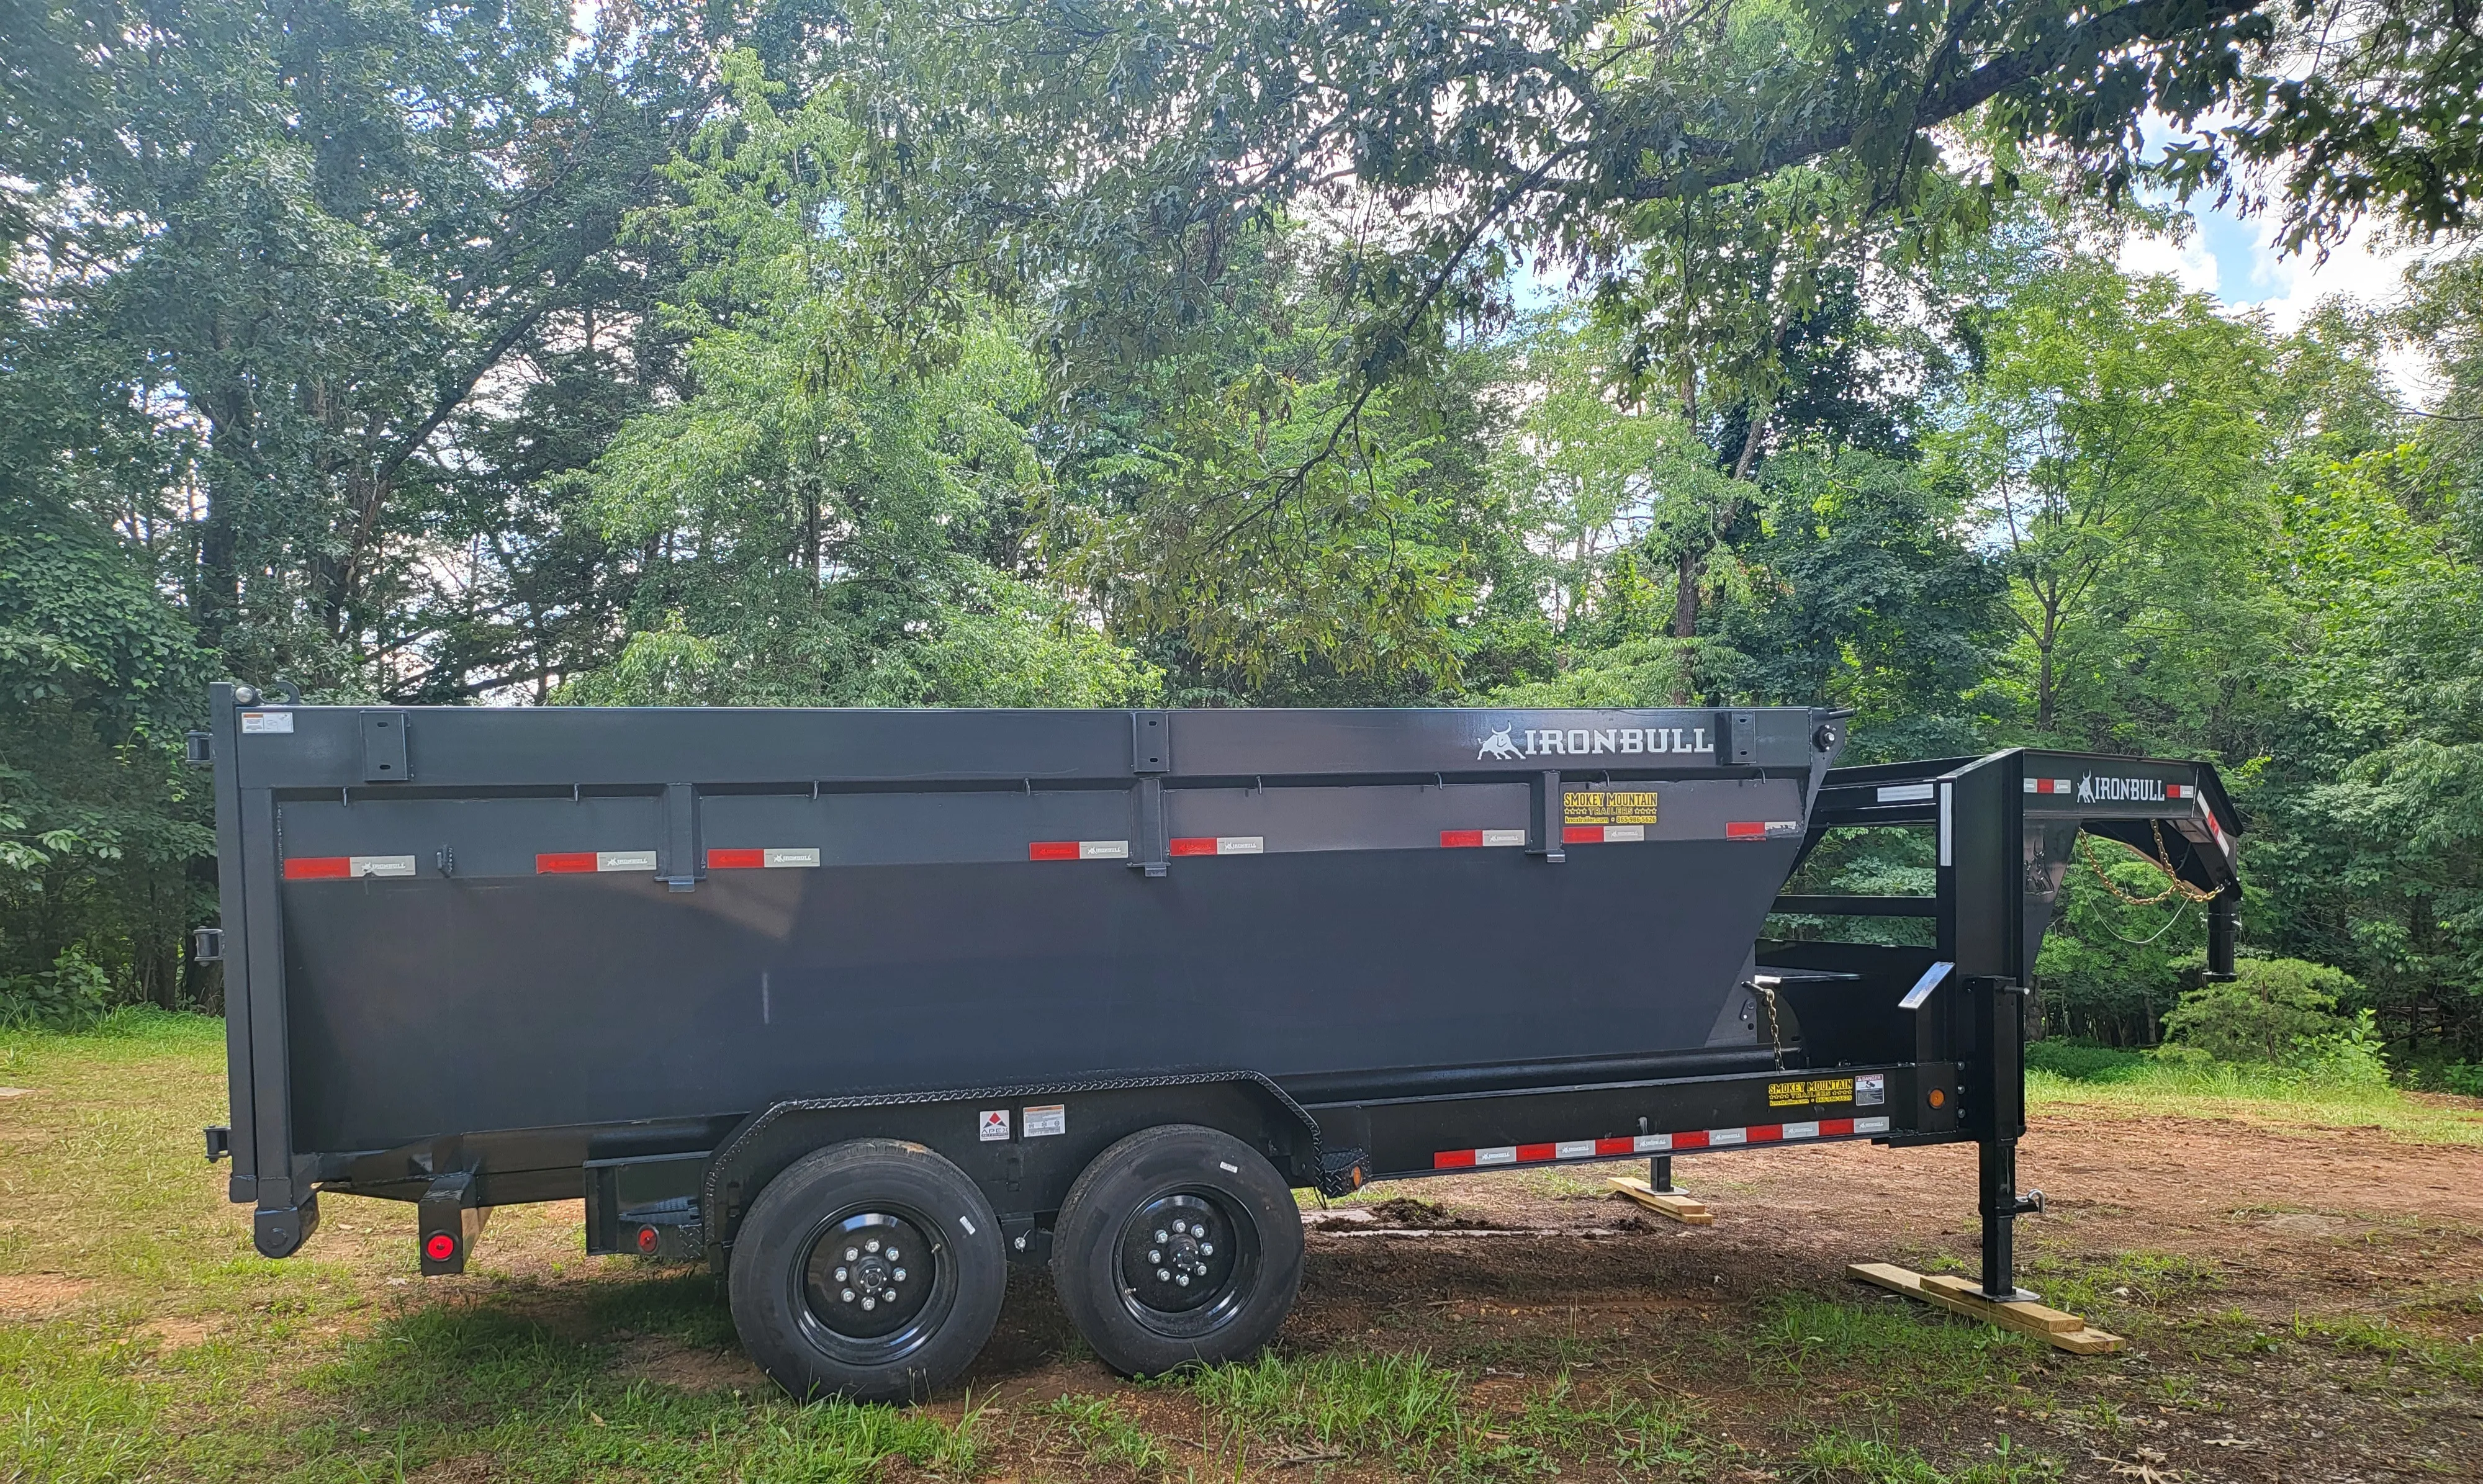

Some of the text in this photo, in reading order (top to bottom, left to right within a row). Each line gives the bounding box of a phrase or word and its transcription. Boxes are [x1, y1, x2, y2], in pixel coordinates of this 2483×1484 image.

[1525, 728, 1714, 755] IRONBULL
[2095, 776, 2165, 802] IRONBULL
[1564, 792, 1657, 806] SMOKEY MOUNTAIN
[1769, 1079, 1853, 1094] SMOKEY MOUNTAIN
[1791, 1091, 1831, 1099] TRAILERS
